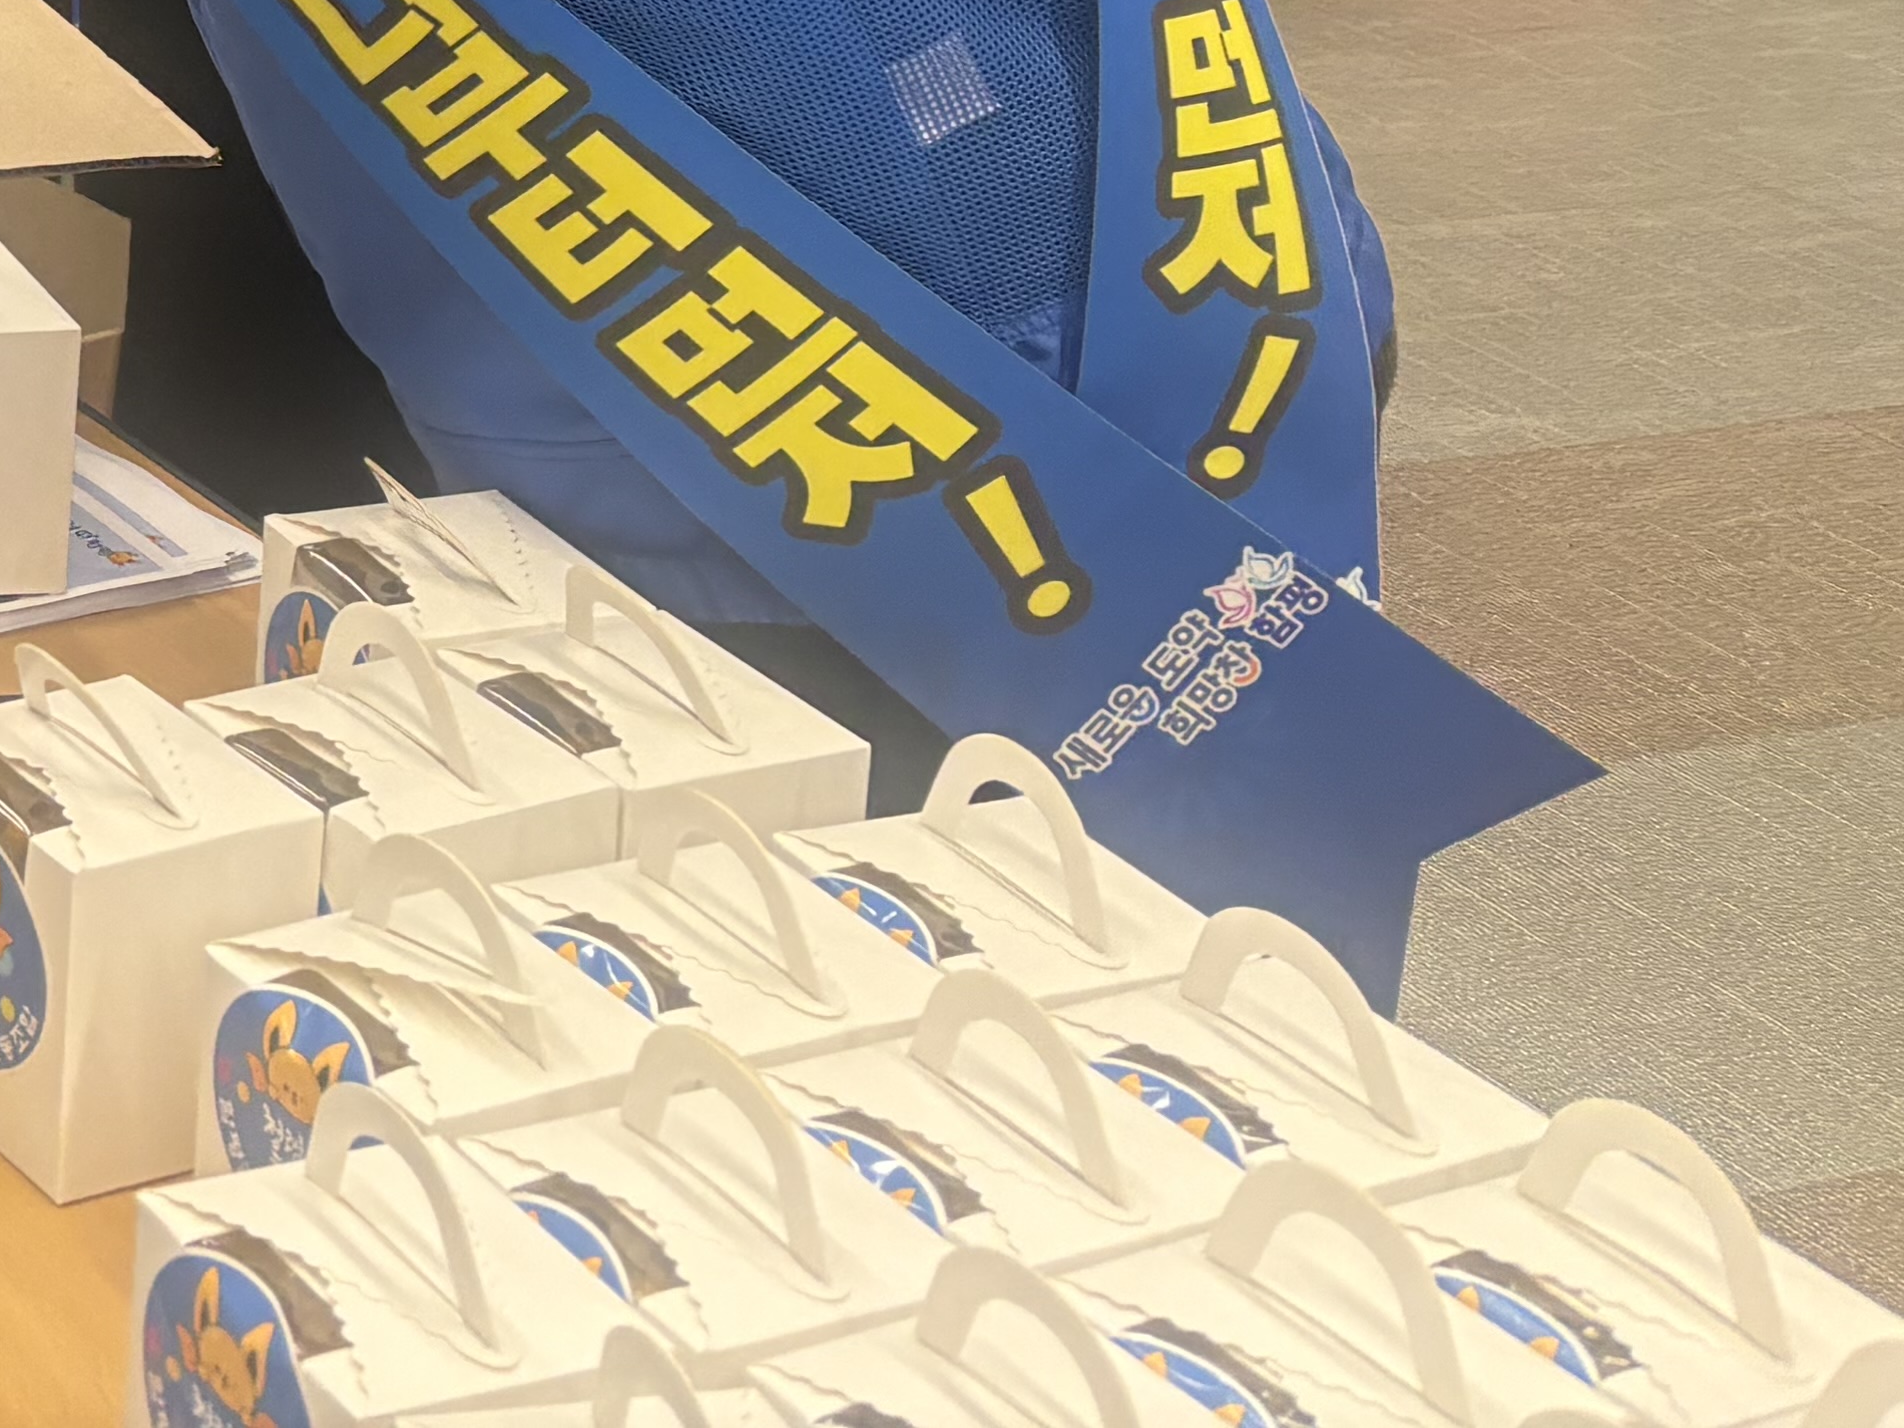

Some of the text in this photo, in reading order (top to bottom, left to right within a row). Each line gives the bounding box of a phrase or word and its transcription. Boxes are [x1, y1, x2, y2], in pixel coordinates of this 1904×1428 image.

[1158, 5, 1312, 482] 먼저!
[612, 248, 1078, 620] 먼저!
[1054, 610, 1224, 778] 새로운 도약
[1159, 571, 1328, 745] 희망찬 함평
